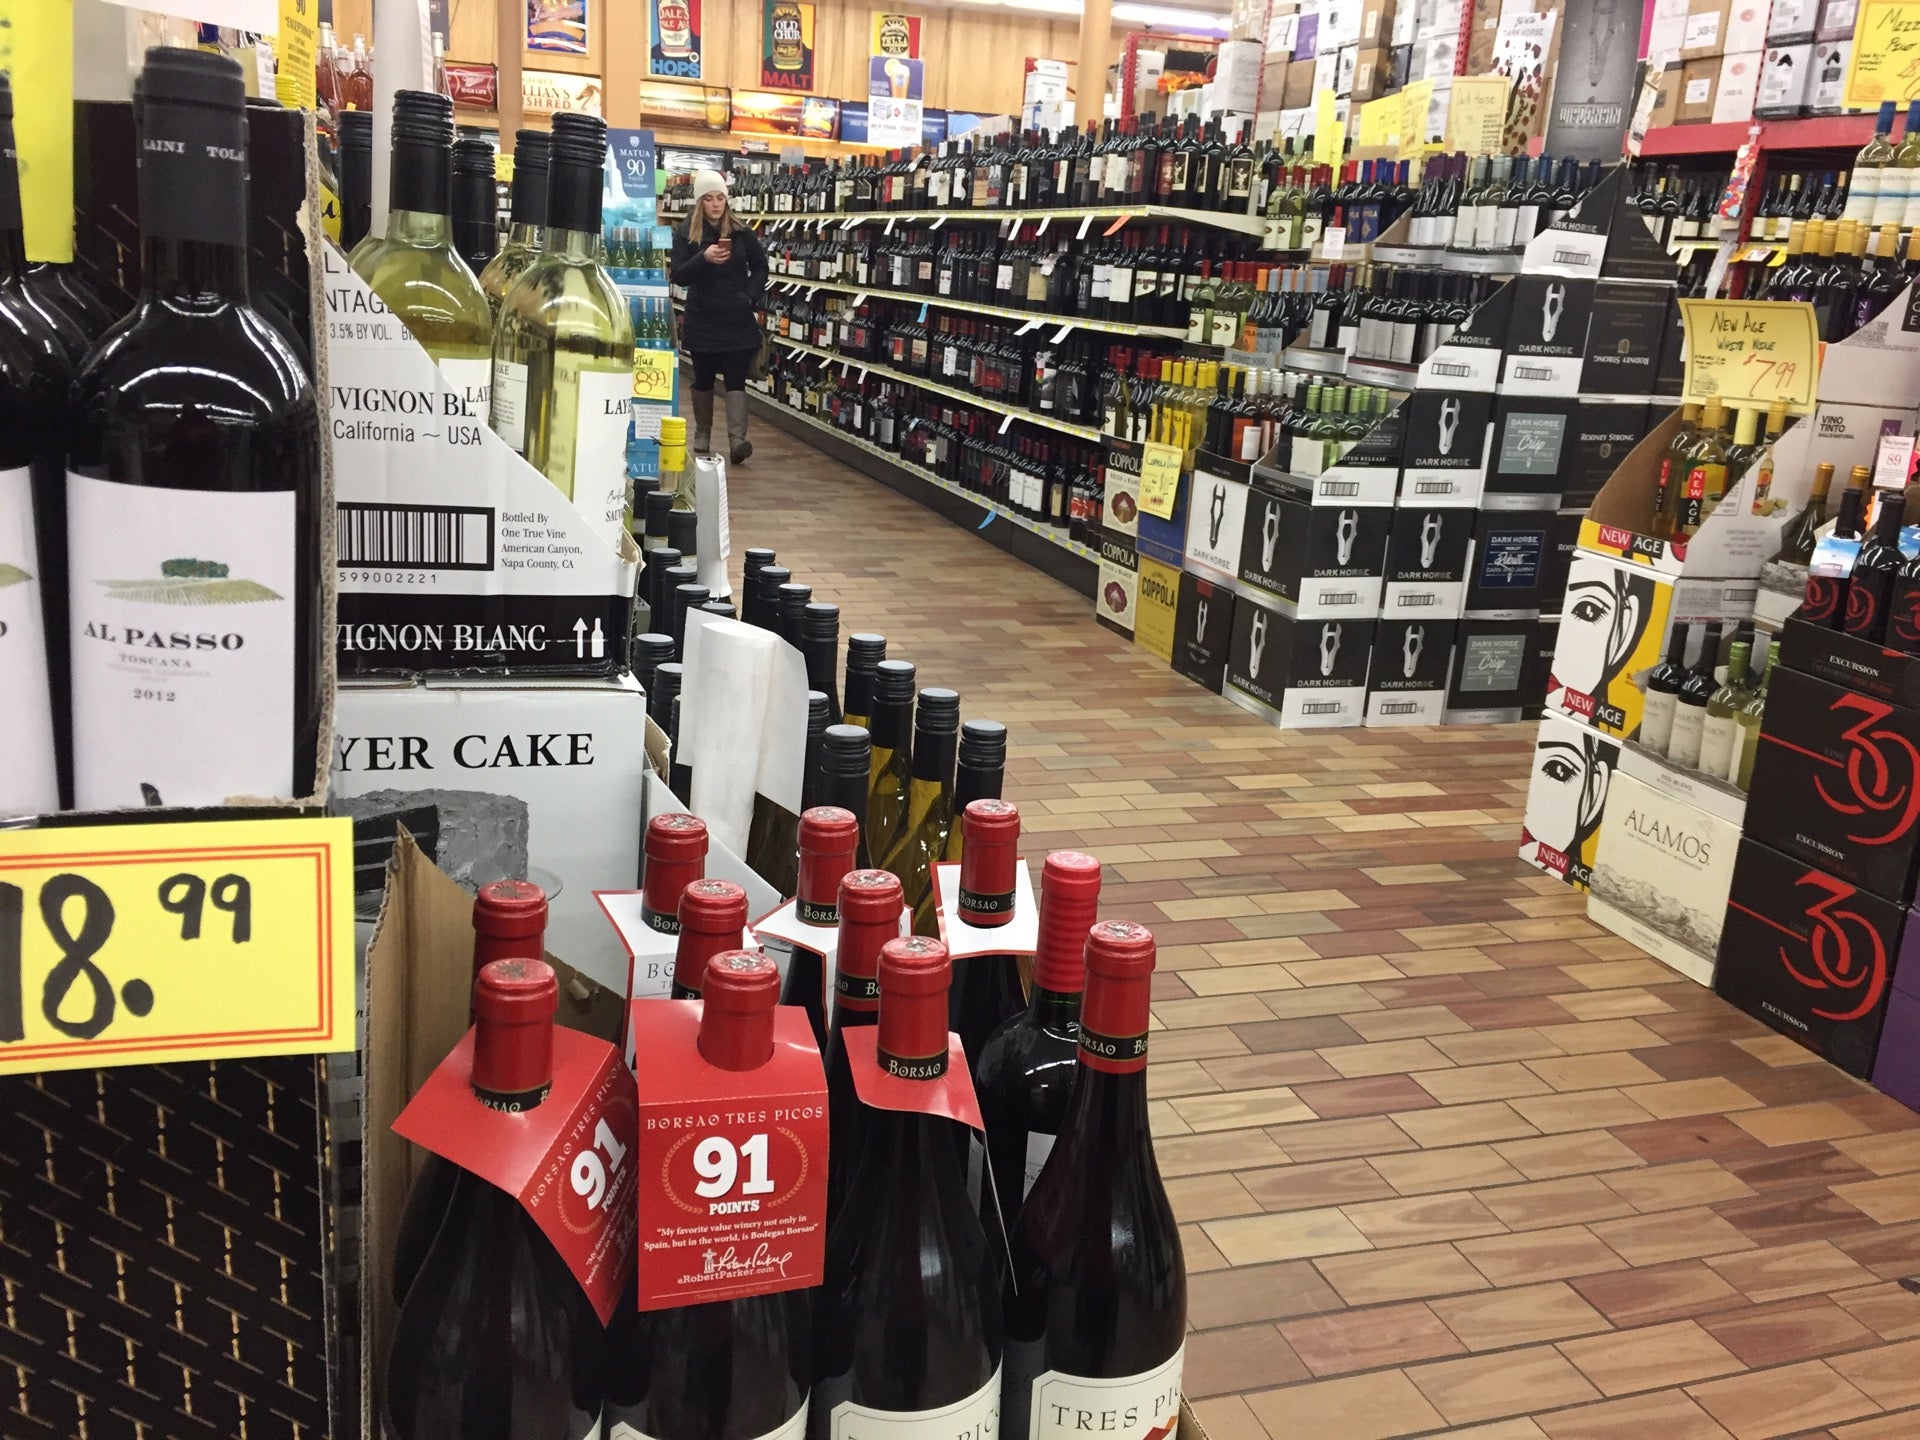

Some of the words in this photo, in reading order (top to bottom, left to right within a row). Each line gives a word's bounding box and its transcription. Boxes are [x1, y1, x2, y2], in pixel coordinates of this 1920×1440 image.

[774, 30, 800, 41] CHUB
[775, 20, 798, 31] OLD
[651, 58, 700, 78] HOPS
[763, 71, 810, 89] MALT
[546, 98, 572, 110] RED
[620, 148, 651, 158] MATUA
[627, 158, 646, 178] 90
[1572, 222, 1599, 233] HORSE
[1710, 309, 1738, 334] NEW
[1742, 310, 1767, 334] AGE
[356, 324, 368, 341] BY
[371, 325, 393, 341] VOL.
[1460, 335, 1492, 347] HORSE
[1518, 344, 1541, 354] DARK
[1541, 345, 1574, 355] HORSE
[443, 391, 477, 418] BL
[1510, 418, 1532, 427] DARK
[1819, 423, 1847, 433] TINTO
[1822, 415, 1844, 425] VINO
[333, 417, 416, 444] California
[447, 425, 482, 447] USA
[1581, 432, 1608, 441] RODNEY
[1608, 433, 1634, 441] STRONG
[1415, 457, 1440, 466] DARK
[1440, 458, 1470, 467] HORSE
[1886, 454, 1902, 466] 89
[1690, 471, 1703, 498] NEW
[501, 511, 534, 524] Bottled
[536, 512, 549, 526] By
[1687, 500, 1699, 525] AGE
[501, 528, 521, 539] One
[523, 528, 545, 540] True
[547, 528, 567, 540] Vine
[1491, 535, 1512, 544] DARK
[1512, 536, 1538, 544] HORSE
[1600, 527, 1631, 546] NEW
[1633, 538, 1662, 554] AGE
[500, 542, 546, 555] American
[547, 543, 583, 557] Canyon,
[1102, 541, 1136, 568] COPPOLA
[1193, 547, 1212, 562] DARK
[1211, 556, 1231, 570] HORSE
[501, 557, 525, 570] Napa
[526, 558, 560, 571] County,
[562, 559, 575, 570] CA
[1313, 568, 1338, 577] DARK
[1338, 568, 1370, 577] HORSE
[339, 571, 438, 585] 599002221
[1244, 568, 1265, 587] DARK
[1264, 577, 1288, 595] HORSE
[1397, 571, 1421, 580] DARK
[1421, 572, 1452, 581] HORSE
[1141, 576, 1176, 609] COPPOLA
[83, 620, 116, 643] AL
[124, 627, 245, 651] PASSO
[452, 624, 547, 652] BLANC
[1471, 639, 1494, 648] DARK
[1829, 655, 1880, 677] EXCURSION
[1233, 673, 1250, 691] DARK
[1250, 684, 1273, 702] HORSE
[1297, 679, 1321, 687] DARK
[1321, 678, 1353, 687] HORSE
[1381, 680, 1404, 689] DARK
[1404, 681, 1435, 689] HORSE
[133, 687, 177, 702] 2012
[1566, 689, 1594, 712] NEW
[1596, 706, 1624, 726] AGE
[452, 732, 596, 769] CAKE
[1624, 808, 1711, 866] ALAMOS
[1796, 832, 1845, 860] EXCURSION
[1539, 846, 1568, 869] NEW
[959, 893, 999, 910] BORSAO
[652, 915, 679, 931] BOR
[1761, 1000, 1809, 1032] EXCURSION
[888, 1058, 942, 1078] BORSAO
[646, 1112, 720, 1131] BORSAO
[725, 1110, 767, 1127] TRES
[774, 1106, 824, 1122] PICOS
[529, 1140, 573, 1208] BORSAO
[571, 1102, 597, 1143] TRES
[570, 1117, 628, 1211] 91
[692, 1132, 776, 1200] 91
[601, 1166, 627, 1213] POINTS
[708, 1199, 761, 1216] POINTS
[676, 1225, 709, 1236] favorite
[710, 1223, 733, 1233] value
[733, 1221, 762, 1232] winery
[763, 1218, 778, 1227] not
[778, 1216, 797, 1227] only
[798, 1214, 807, 1223] in
[643, 1240, 671, 1252] Spain,
[672, 1238, 687, 1249] but
[688, 1237, 698, 1247] in
[698, 1236, 713, 1246] the
[714, 1233, 741, 1244] world,
[742, 1232, 750, 1241] is
[750, 1228, 786, 1240] Bodegas
[1051, 1403, 1139, 1432] TRES
